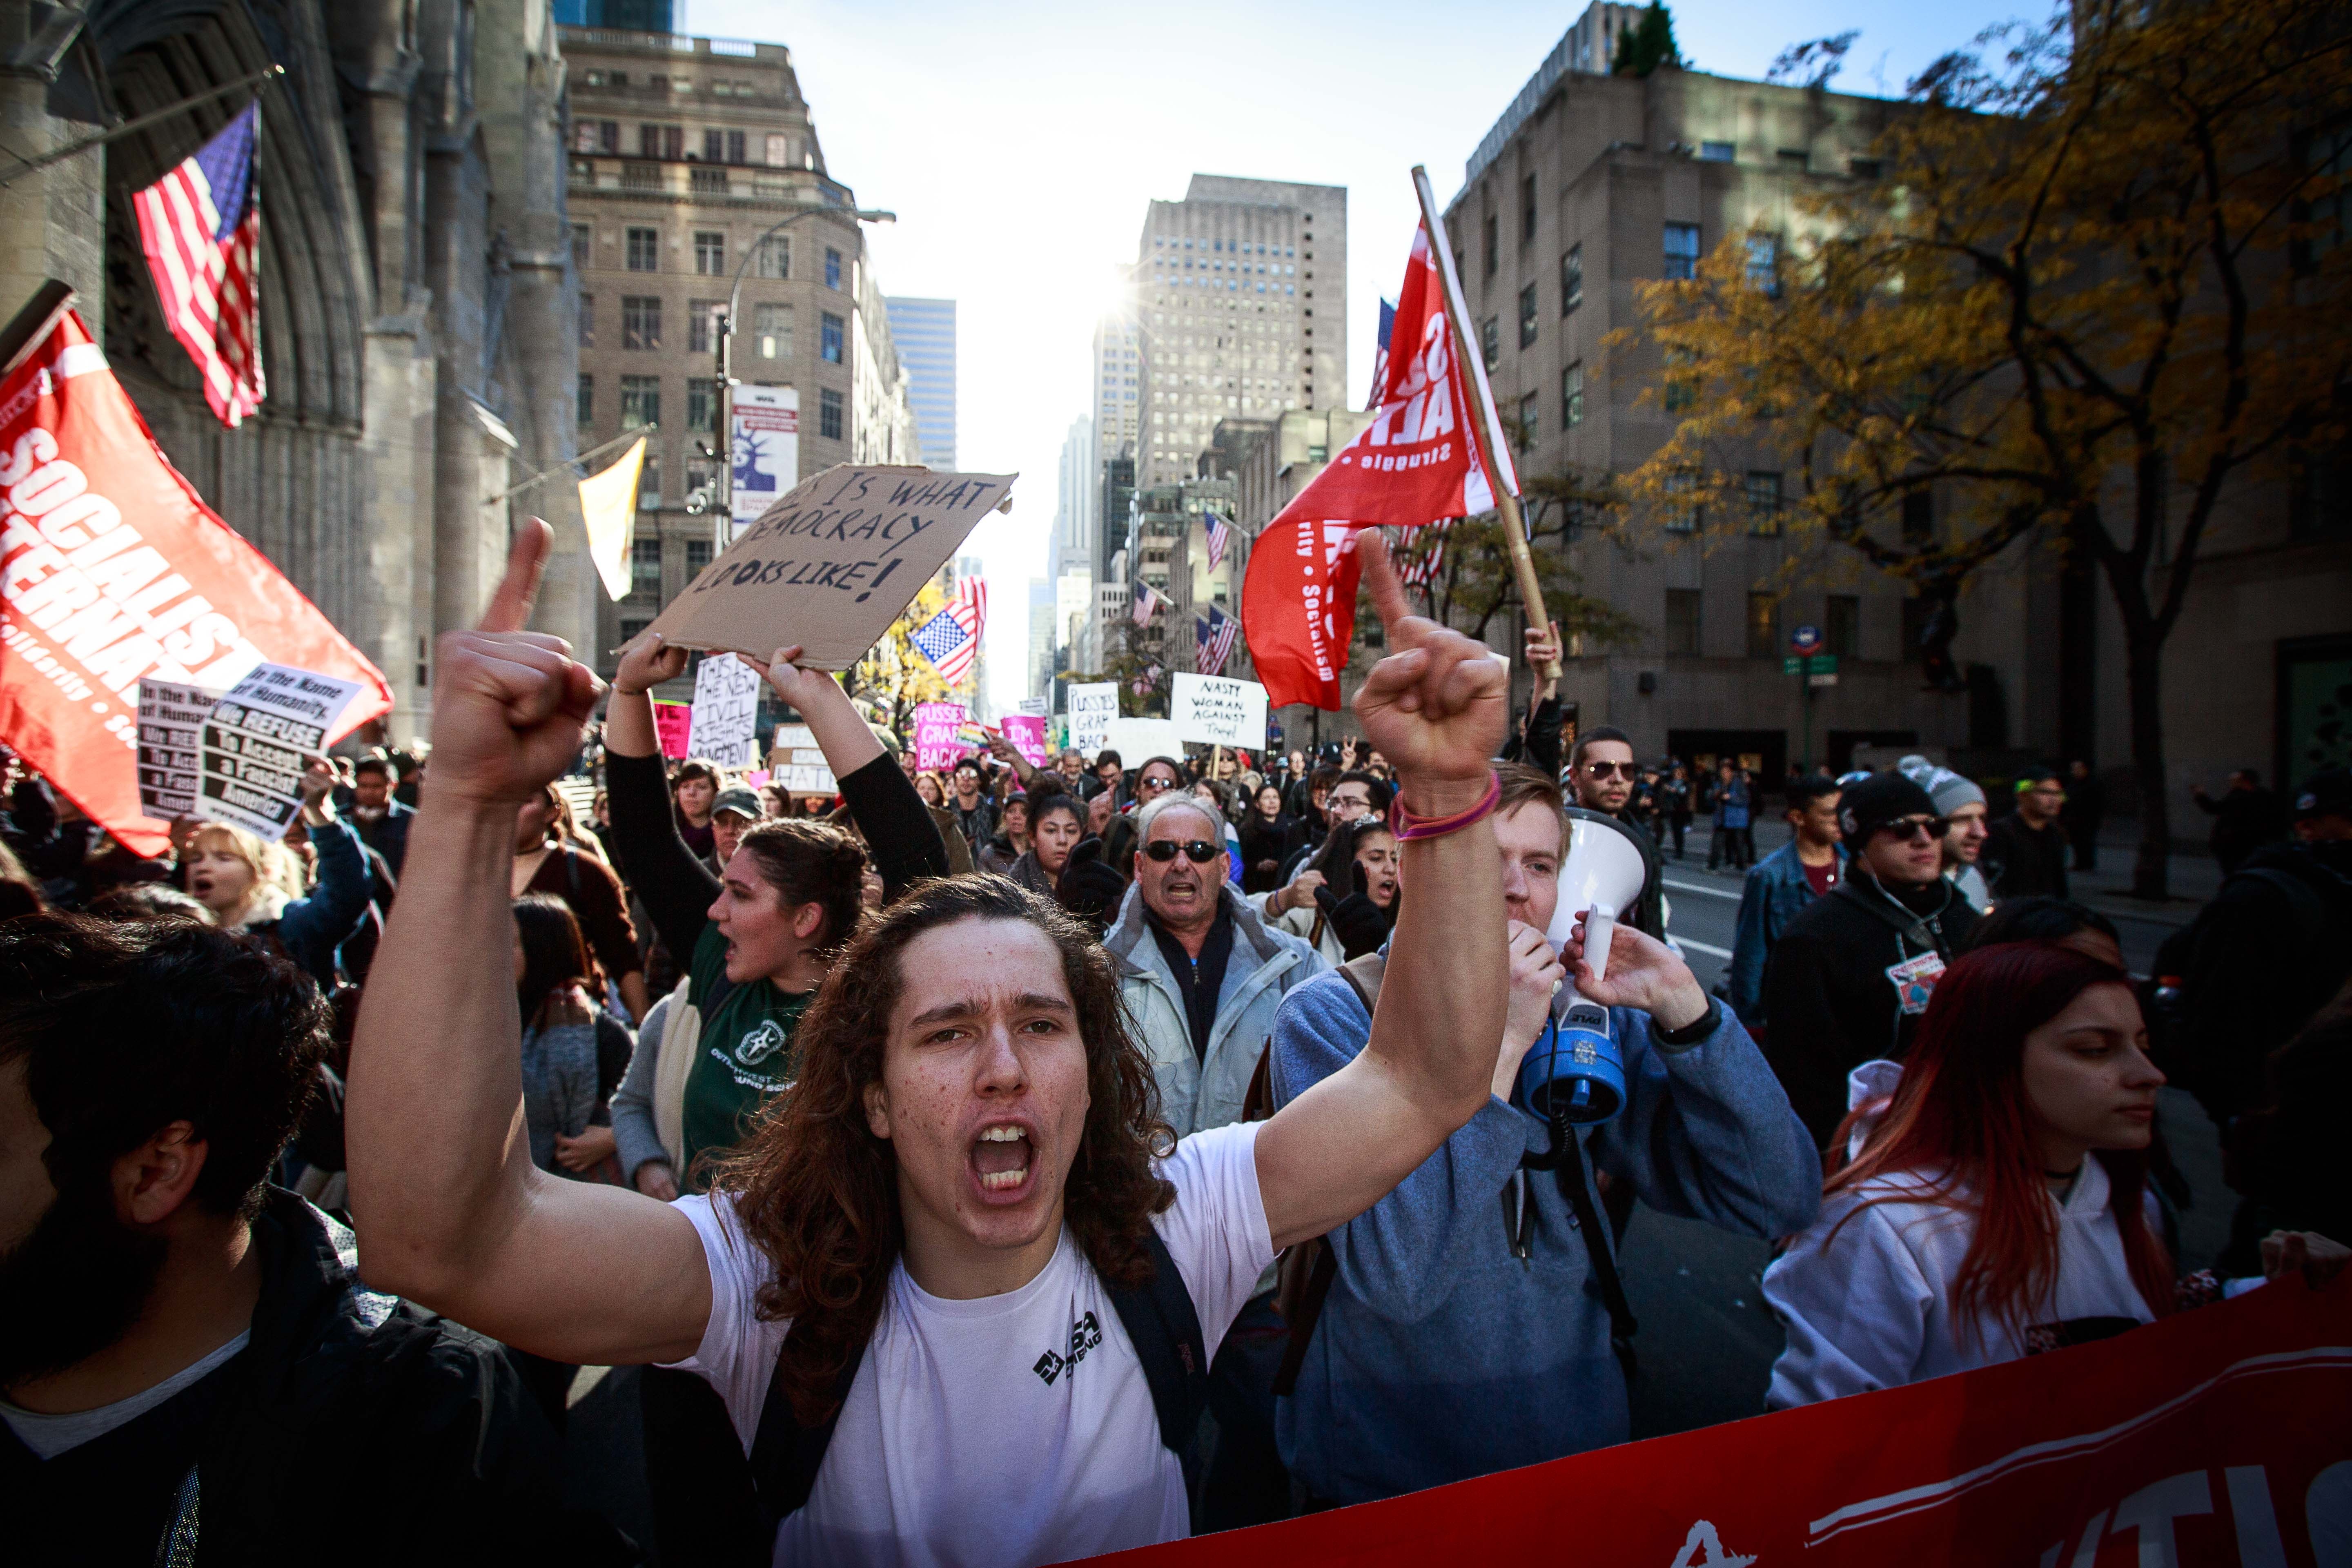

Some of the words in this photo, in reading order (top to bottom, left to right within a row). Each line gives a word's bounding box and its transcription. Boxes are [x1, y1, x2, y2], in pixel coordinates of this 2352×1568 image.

[822, 471, 877, 506] IS
[888, 479, 996, 510] WHAT
[693, 559, 794, 592] LOOKS
[786, 558, 903, 603] LIKE!
[1302, 584, 1334, 682] Socialism
[699, 656, 731, 681] THIS
[295, 677, 343, 699] Name
[696, 679, 721, 702] THE
[725, 674, 755, 697] NEW
[1200, 681, 1241, 697] NASTY
[693, 699, 752, 729] CIVIL
[1191, 697, 1244, 710] WOMAN
[1192, 709, 1247, 724] AGAINST
[242, 709, 322, 749] REFUSE
[241, 736, 303, 772] Accept
[919, 747, 960, 768] BACK
[1071, 1311, 1100, 1350] SA
